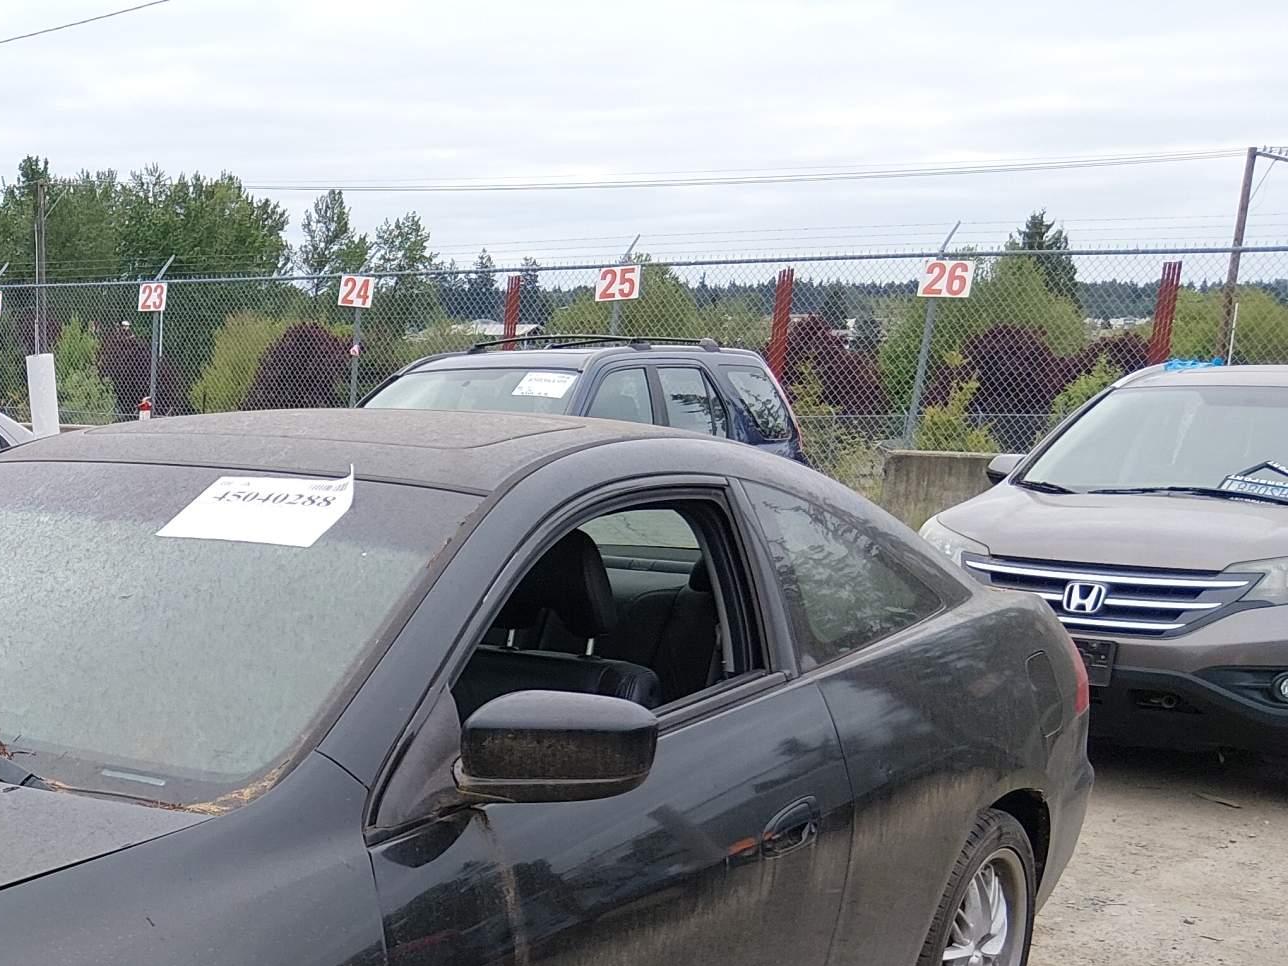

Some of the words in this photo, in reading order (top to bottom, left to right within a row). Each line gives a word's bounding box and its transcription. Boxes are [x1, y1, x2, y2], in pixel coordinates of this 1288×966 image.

[341, 277, 370, 305] 24
[598, 267, 636, 299] 25
[921, 262, 969, 296] 26
[140, 285, 164, 310] 23
[212, 490, 337, 507] 45040288
